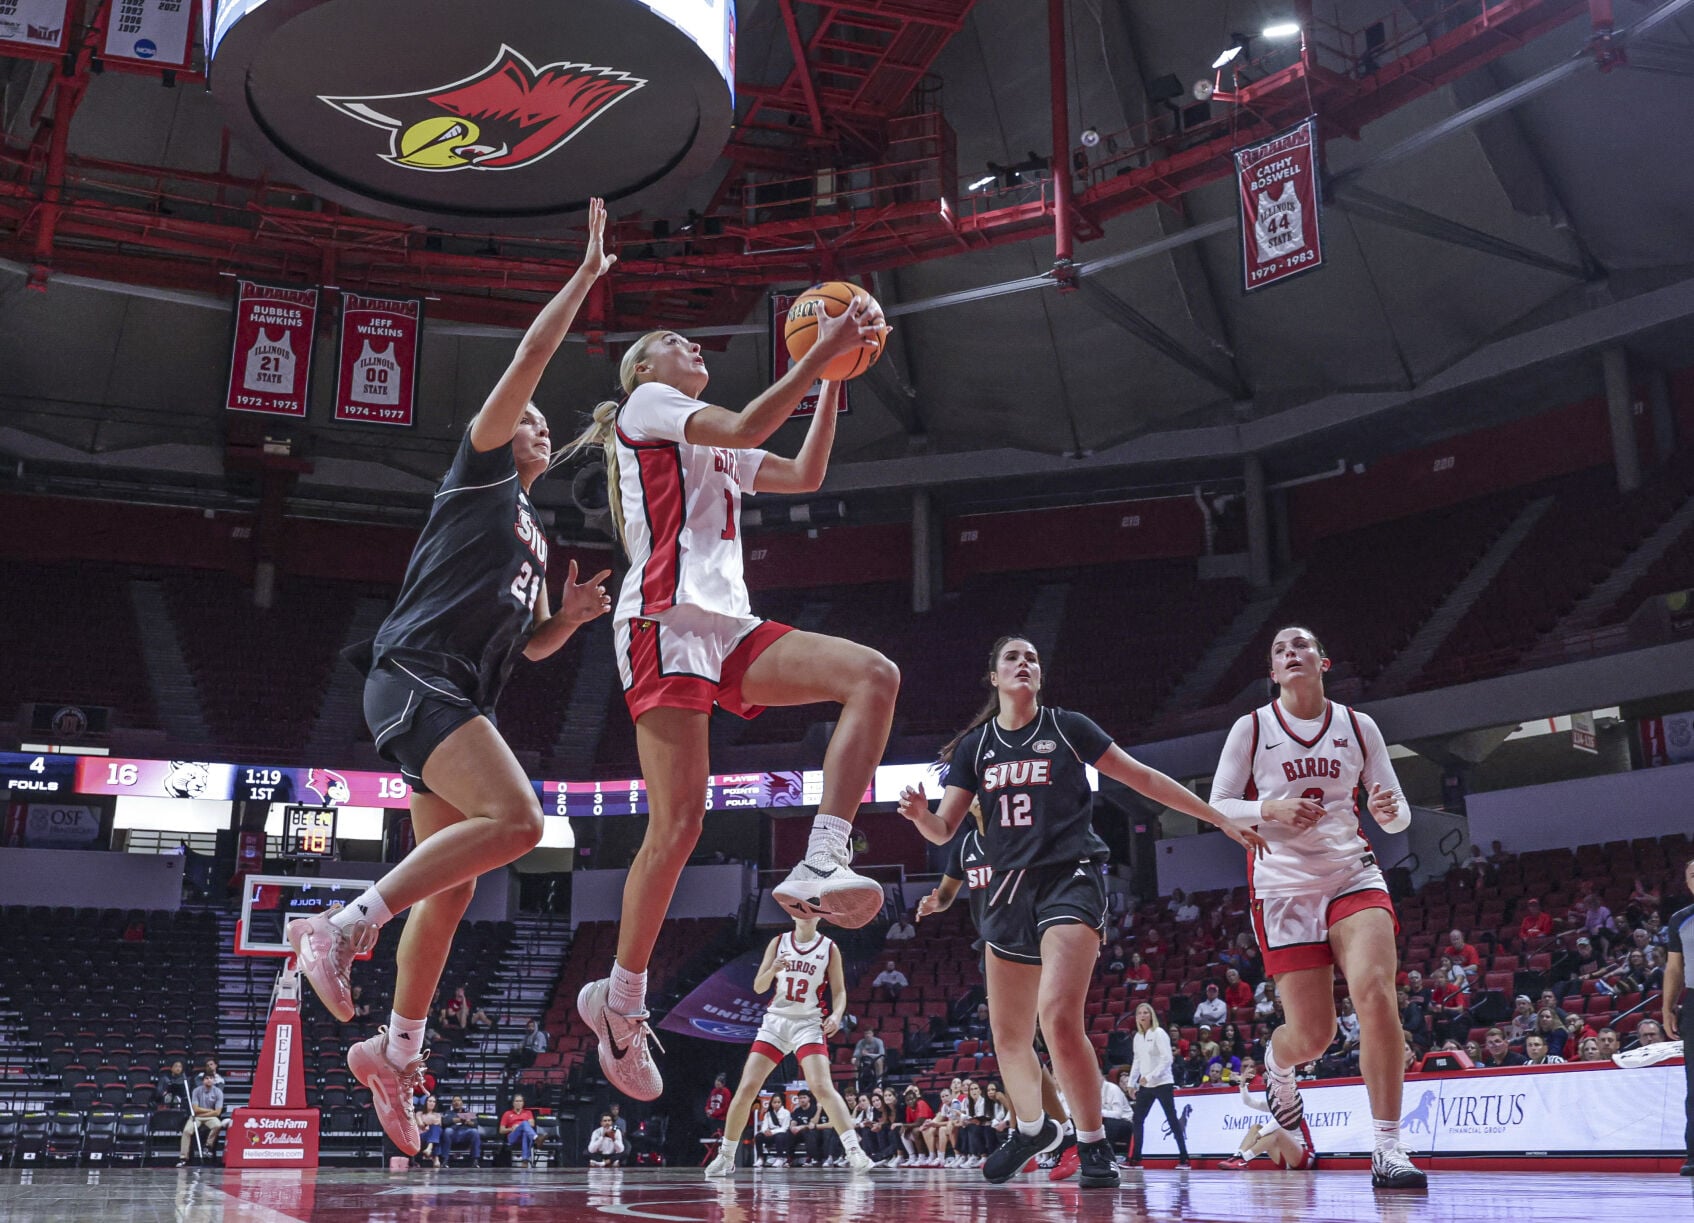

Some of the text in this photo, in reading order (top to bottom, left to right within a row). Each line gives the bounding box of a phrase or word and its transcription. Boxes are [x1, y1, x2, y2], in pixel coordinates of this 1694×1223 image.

[1256, 156, 1293, 178] CATHY
[1250, 164, 1302, 191] BOSWELL
[1259, 201, 1296, 225] ILLINOIS
[1267, 213, 1290, 234] 44
[1268, 230, 1293, 249] STATE
[1251, 262, 1277, 281] 1979
[1286, 249, 1315, 268] 1983
[250, 312, 303, 327] HAWKINS
[253, 305, 301, 318] BUBBLES
[369, 317, 392, 328] JEFF
[357, 325, 403, 338] WILKINS
[254, 345, 290, 360] ILLINOIS
[260, 356, 281, 372] 21
[360, 356, 395, 371] ILLINOIS
[256, 372, 282, 384] STATE
[365, 368, 388, 384] 00
[362, 384, 388, 396] STATE
[237, 395, 262, 407] 1972
[272, 399, 298, 410] 1975
[344, 405, 369, 416] 1974
[379, 409, 404, 419] 1977
[720, 487, 737, 541] 1
[513, 507, 548, 571] SIU
[510, 560, 541, 612] 21
[28, 755, 46, 774] 4
[1281, 757, 1342, 783] BIRDS
[106, 762, 138, 786] 16
[245, 769, 282, 785] 1:19
[723, 775, 760, 784] PLAYER
[983, 759, 1052, 792] SIUE
[8, 779, 59, 791] FOULS
[378, 777, 408, 799] 19
[557, 782, 568, 793] 0
[594, 781, 602, 793] 1
[723, 787, 760, 796] POINTS
[249, 787, 276, 800] 1ST
[557, 790, 639, 805] 2 3 2
[556, 802, 637, 815] 0 0 1
[705, 798, 757, 810] 0 FOULS
[999, 793, 1033, 828] 12
[51, 809, 83, 826] OSF
[785, 976, 809, 1003] 12
[274, 1026, 290, 1105] HELLER
[1440, 1093, 1526, 1126] VIRTUS
[262, 1131, 304, 1145] Redbirds
[1449, 1126, 1506, 1134] FINANCIAL GROUP
